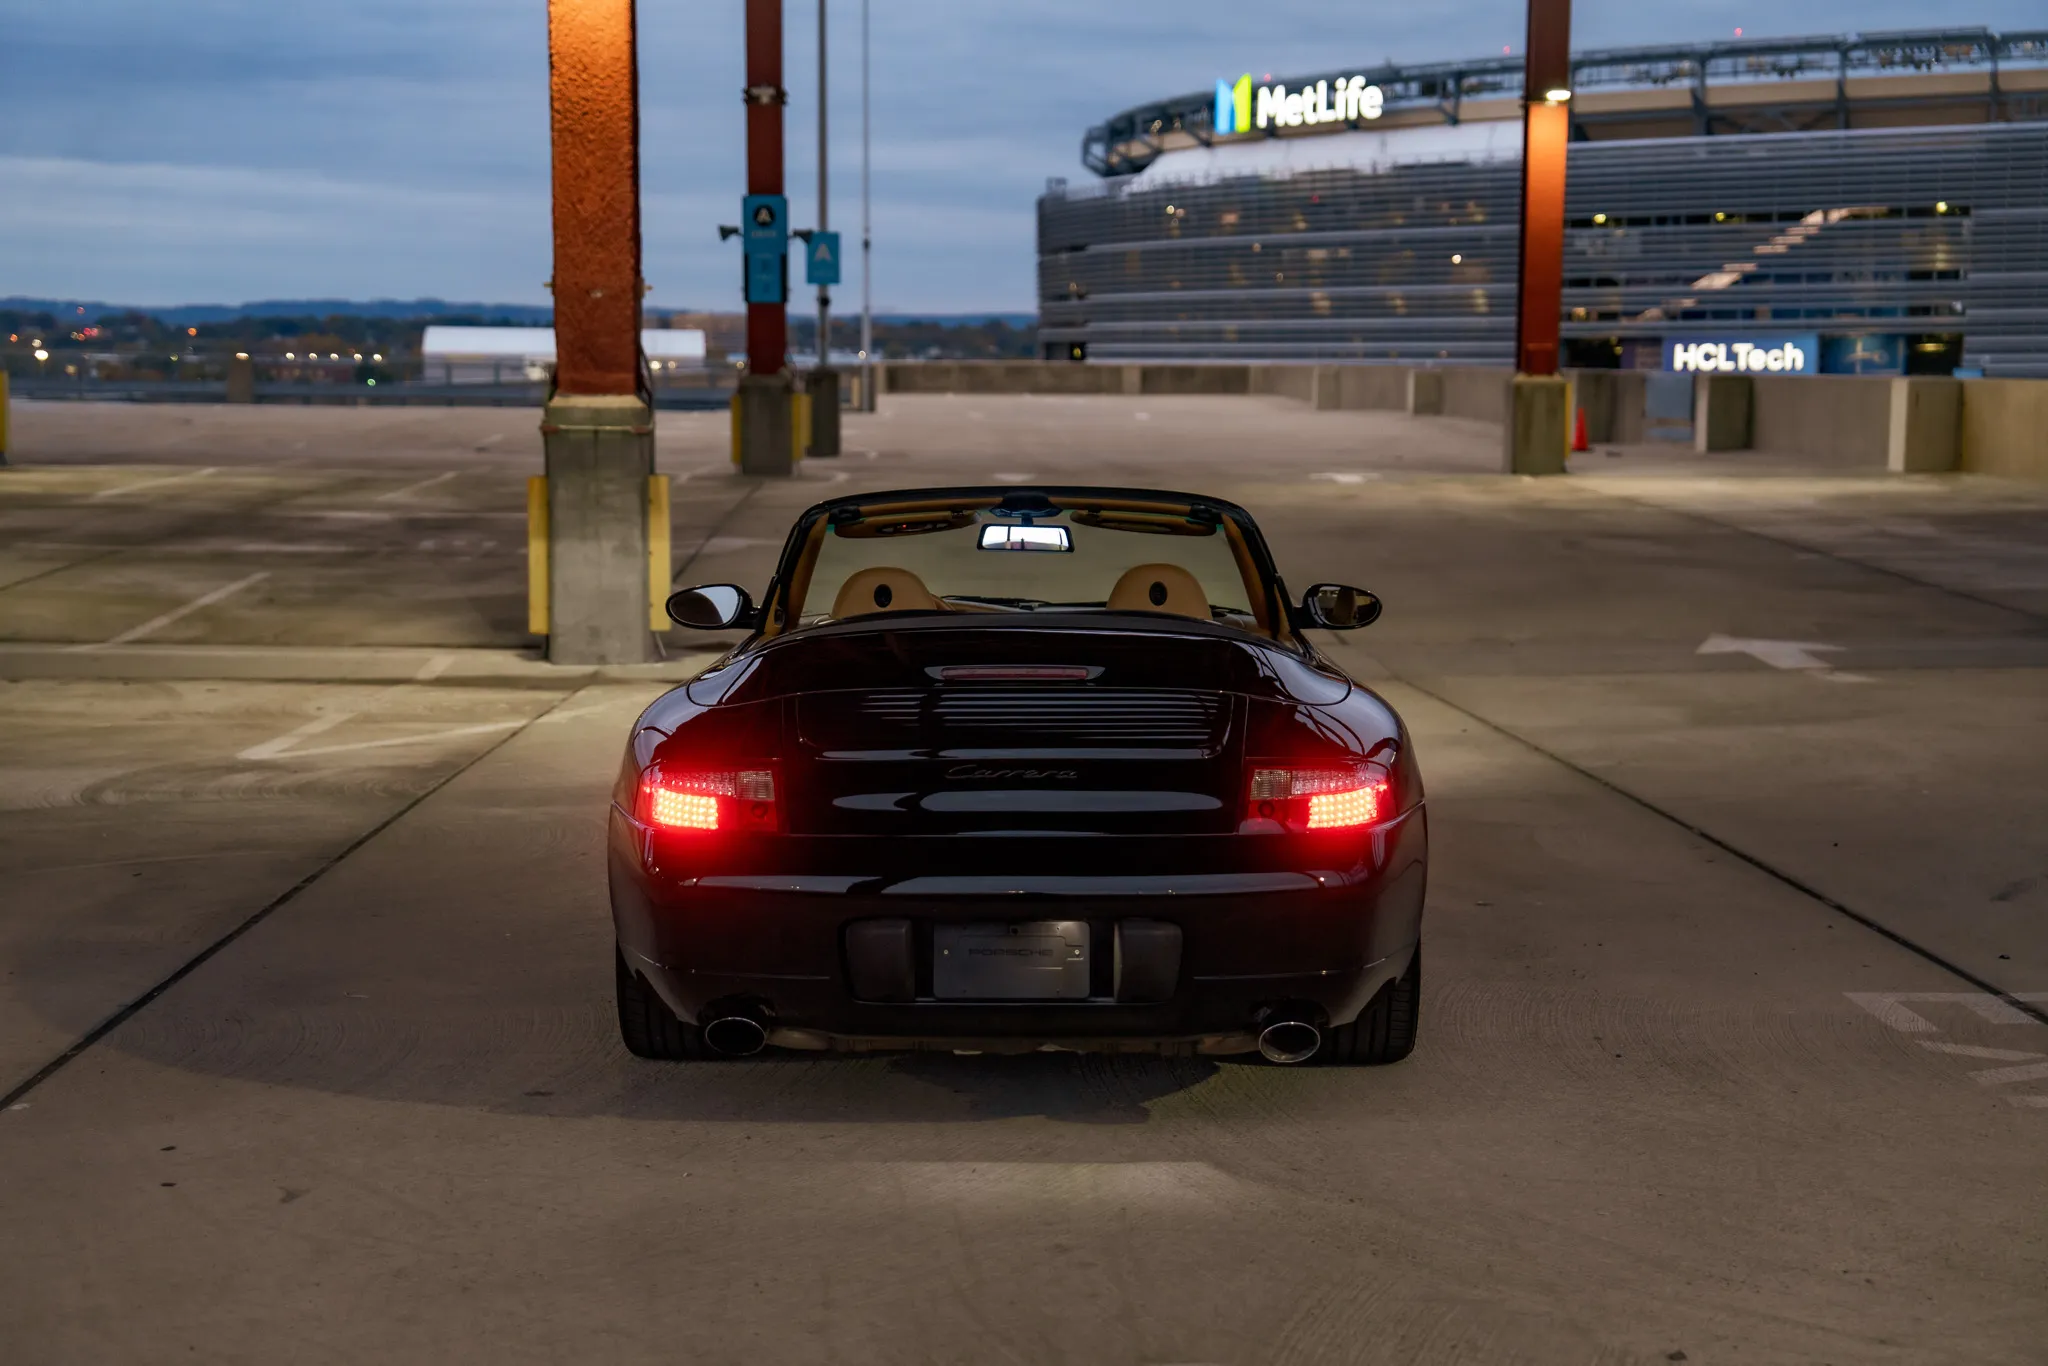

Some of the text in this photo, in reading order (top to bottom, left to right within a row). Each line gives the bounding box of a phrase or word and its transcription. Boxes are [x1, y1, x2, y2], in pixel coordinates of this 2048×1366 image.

[1256, 75, 1384, 129] MetLife
[1673, 342, 1805, 372] HCLTech
[944, 764, 1078, 779] Carrera
[968, 947, 1055, 957] PORSCHE
